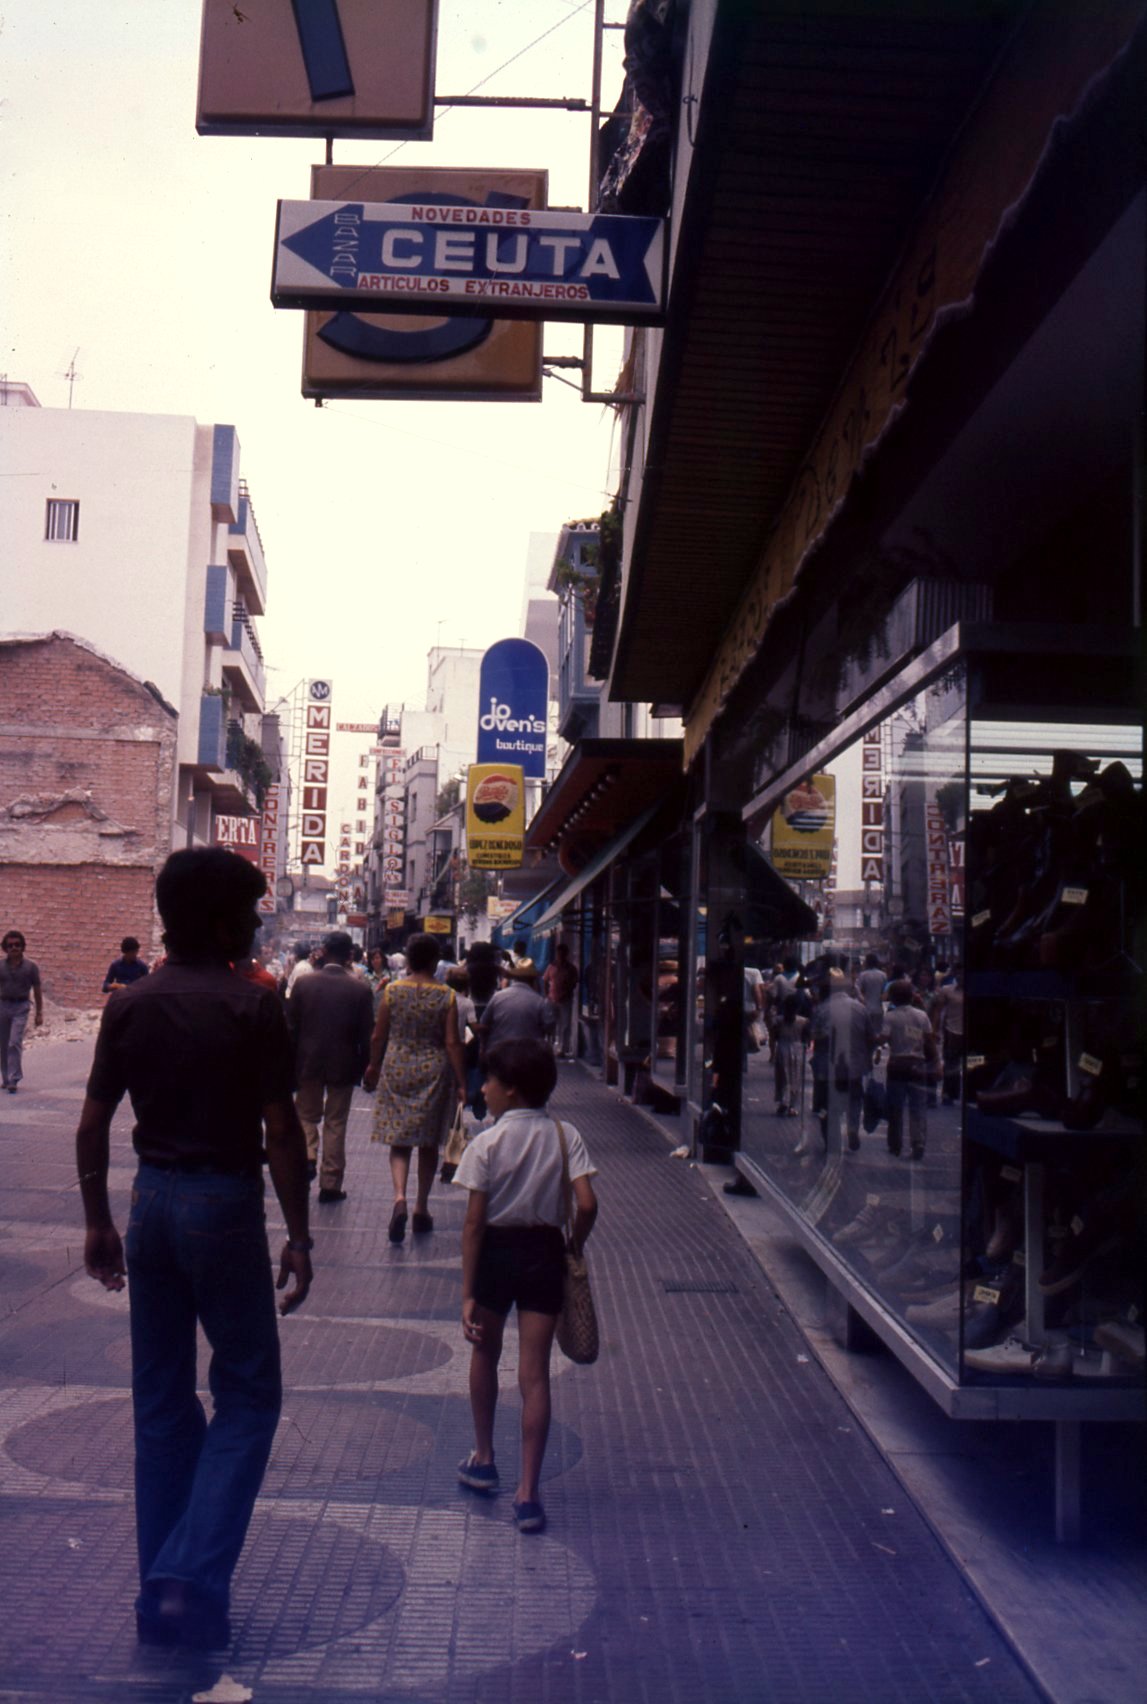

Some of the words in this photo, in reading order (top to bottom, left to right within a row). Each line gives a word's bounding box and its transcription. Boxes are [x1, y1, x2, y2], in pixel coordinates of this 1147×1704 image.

[412, 207, 532, 225] NOVEDADES
[332, 213, 361, 278] BAZAR
[381, 229, 621, 279] CEUTA
[357, 275, 451, 293] ARTICULOS
[465, 280, 589, 300] EXTRANJEROS
[391, 759, 402, 784] EL
[496, 738, 544, 755] boutique
[303, 707, 329, 863] MERIDA
[215, 815, 257, 845] ERTA
[260, 784, 279, 911] CONTRERAS
[386, 801, 401, 869] SIGLO
[338, 824, 351, 914] CARDONA
